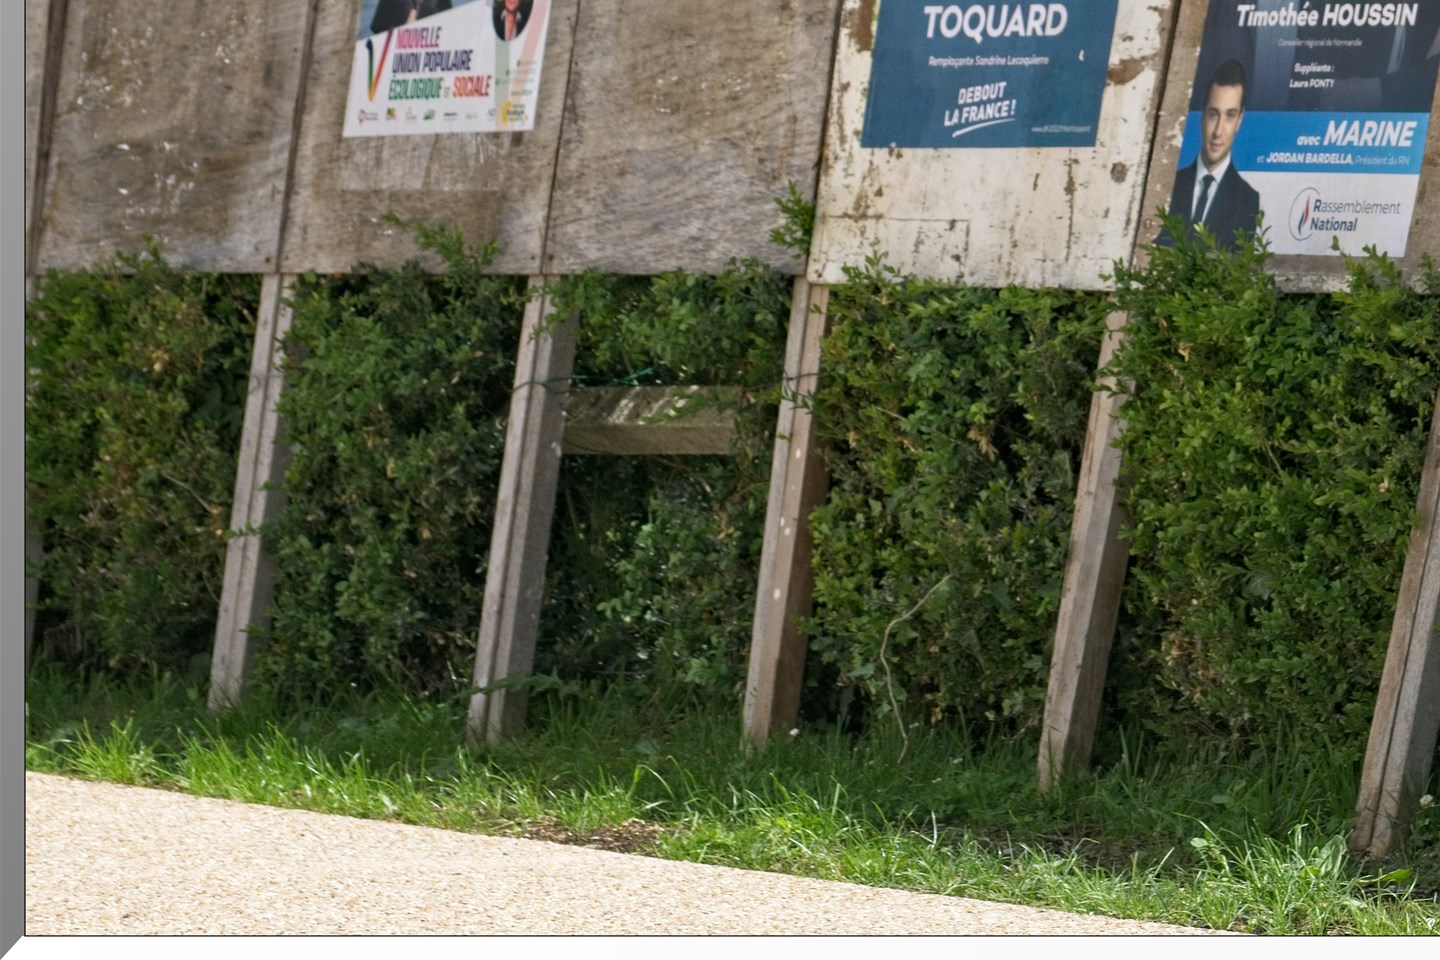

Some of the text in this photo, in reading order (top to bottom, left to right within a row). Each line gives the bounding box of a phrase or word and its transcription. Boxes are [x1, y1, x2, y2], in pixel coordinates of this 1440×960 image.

[923, 4, 1068, 43] TOQUARD
[1237, 1, 1419, 27] Timothée HOUSSIN
[395, 26, 442, 50] NOUVELLE
[392, 49, 474, 74] UNION POPULAIRE
[974, 55, 1006, 66] Sandrine
[453, 74, 492, 98] SOCIALE
[957, 81, 1007, 105] DEBOUT
[1289, 78, 1336, 88] Laura PONTY
[944, 108, 960, 126] LA
[1296, 119, 1418, 147] avec MARINE
[1266, 152, 1303, 164] JORDAN
[1355, 154, 1388, 165] Président
[1313, 198, 1402, 215] Rassemblement
[1310, 216, 1358, 232] National
